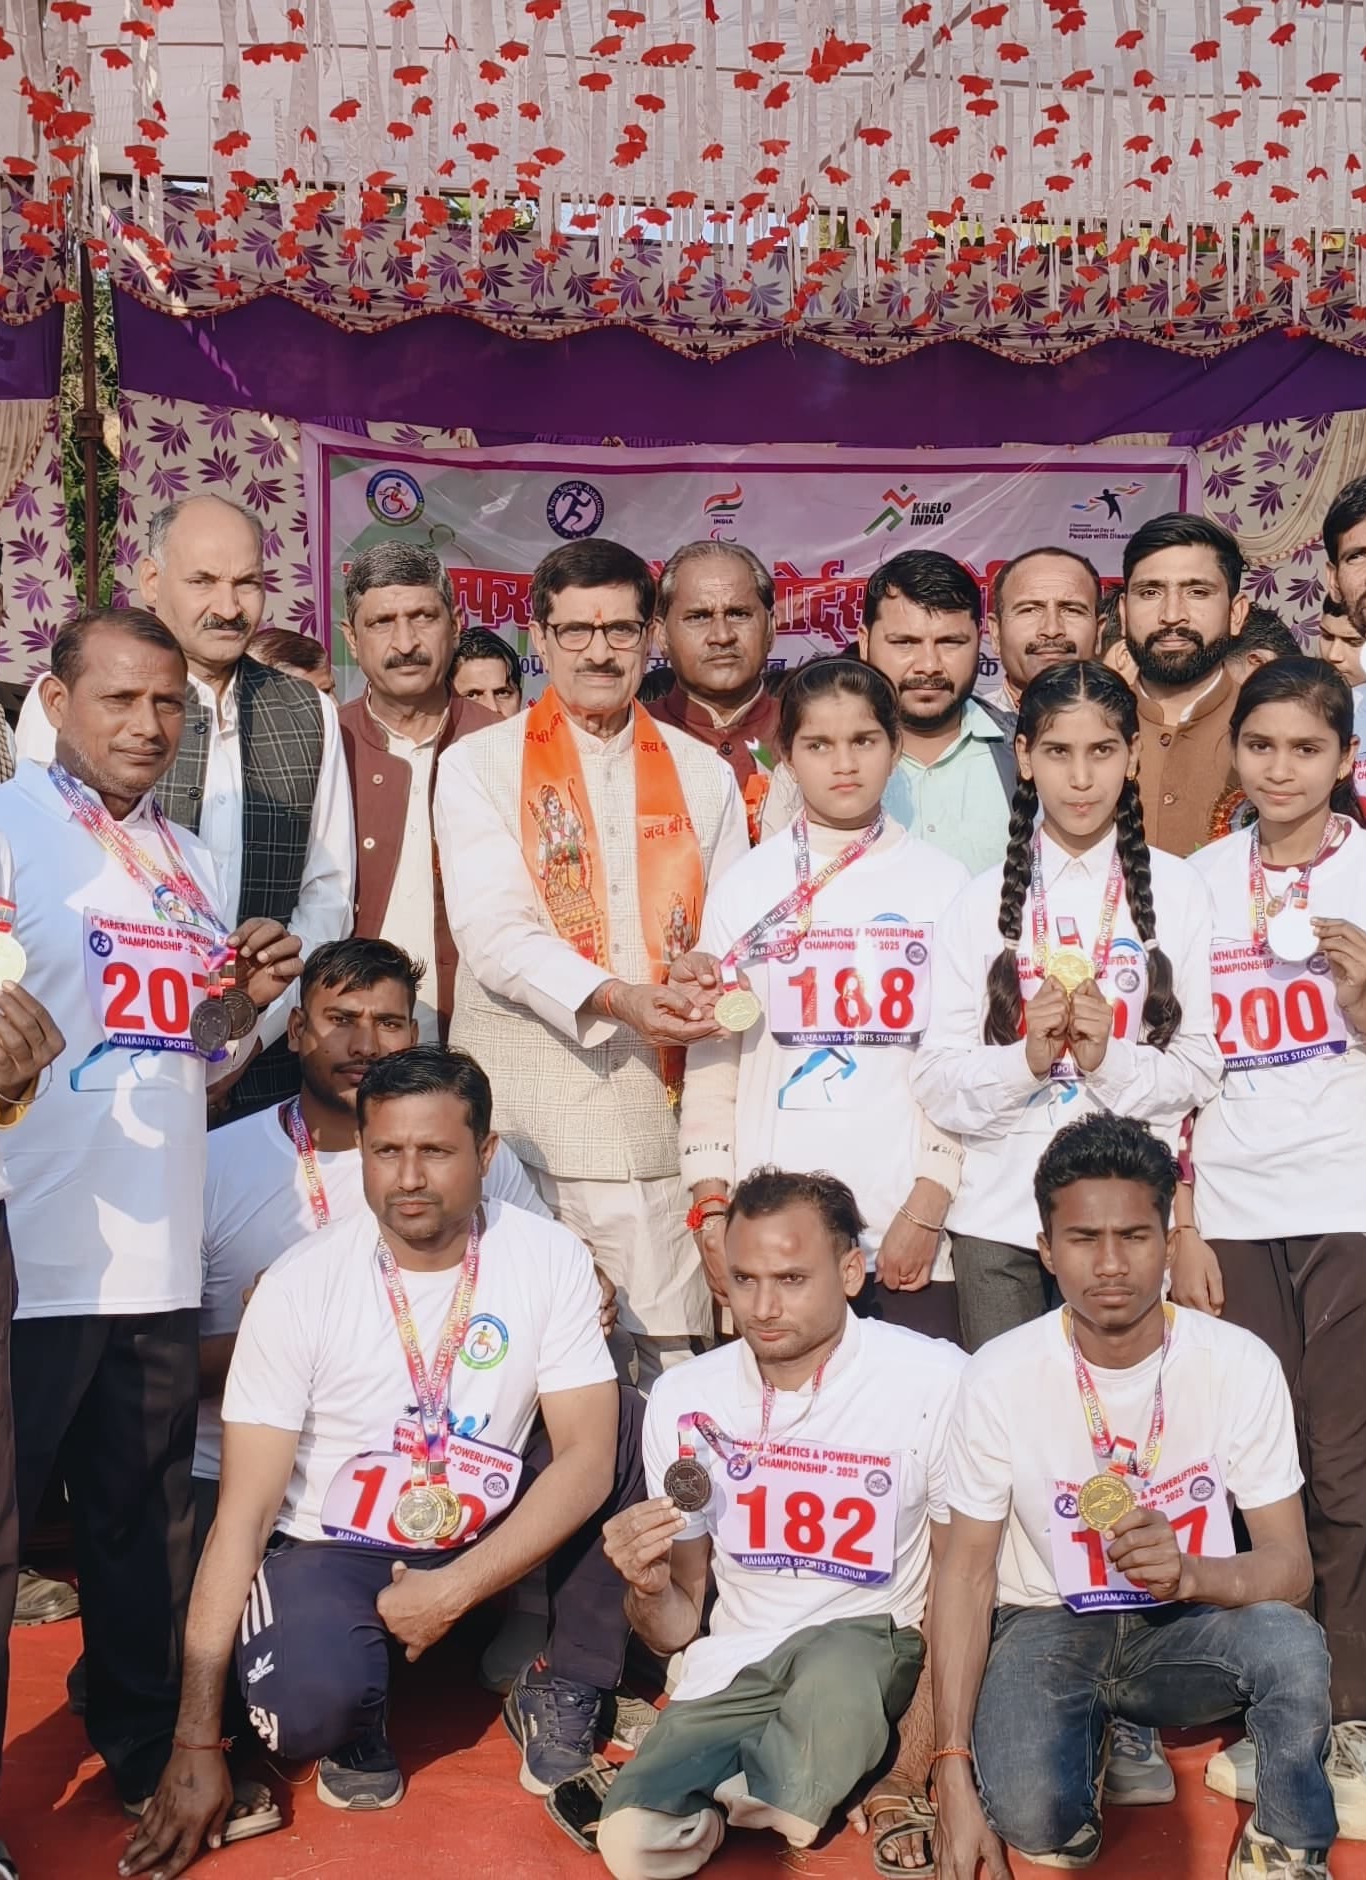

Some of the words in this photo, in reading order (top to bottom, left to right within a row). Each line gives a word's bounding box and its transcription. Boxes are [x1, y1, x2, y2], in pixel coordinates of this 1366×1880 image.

[912, 502, 951, 514] KHELO
[910, 514, 944, 526] INDIA
[743, 922, 765, 946] PARA
[763, 893, 801, 929] ATHLETICS
[807, 844, 861, 891] POWERLIFTING
[810, 928, 853, 938] ATHLETICS
[865, 928, 924, 939] POWERLIFTING
[117, 935, 183, 951] CHAMPIONSHIP
[879, 940, 900, 951] 2025
[750, 945, 772, 958] PARA
[1214, 947, 1257, 962] ATHLETICS
[788, 966, 915, 1030] 188
[1212, 979, 1328, 1055] 200
[164, 1039, 195, 1051] SPORTS
[792, 1033, 842, 1044] MAHAMAYA
[843, 1033, 875, 1043] SPORTS
[876, 1033, 911, 1043] STADIUM
[1258, 1053, 1289, 1066] SPORTS
[1291, 1044, 1332, 1060] STADIUM
[450, 1443, 513, 1473] POWERLIFTING
[822, 1450, 891, 1467] POWERLIFTING
[459, 1461, 481, 1477] 2025
[758, 1457, 828, 1474] CHAMPIONSHIP
[837, 1466, 859, 1479] 2025
[1149, 1462, 1209, 1498] POWERLIFTING
[1165, 1487, 1185, 1503] 2025
[736, 1485, 876, 1566] 182
[1071, 1505, 1208, 1587] 17
[741, 1554, 792, 1567] MAHAMAYA
[794, 1557, 827, 1573] SPORTS
[828, 1563, 867, 1580] STADIUM
[1081, 1592, 1137, 1604] MAHAMAYA
